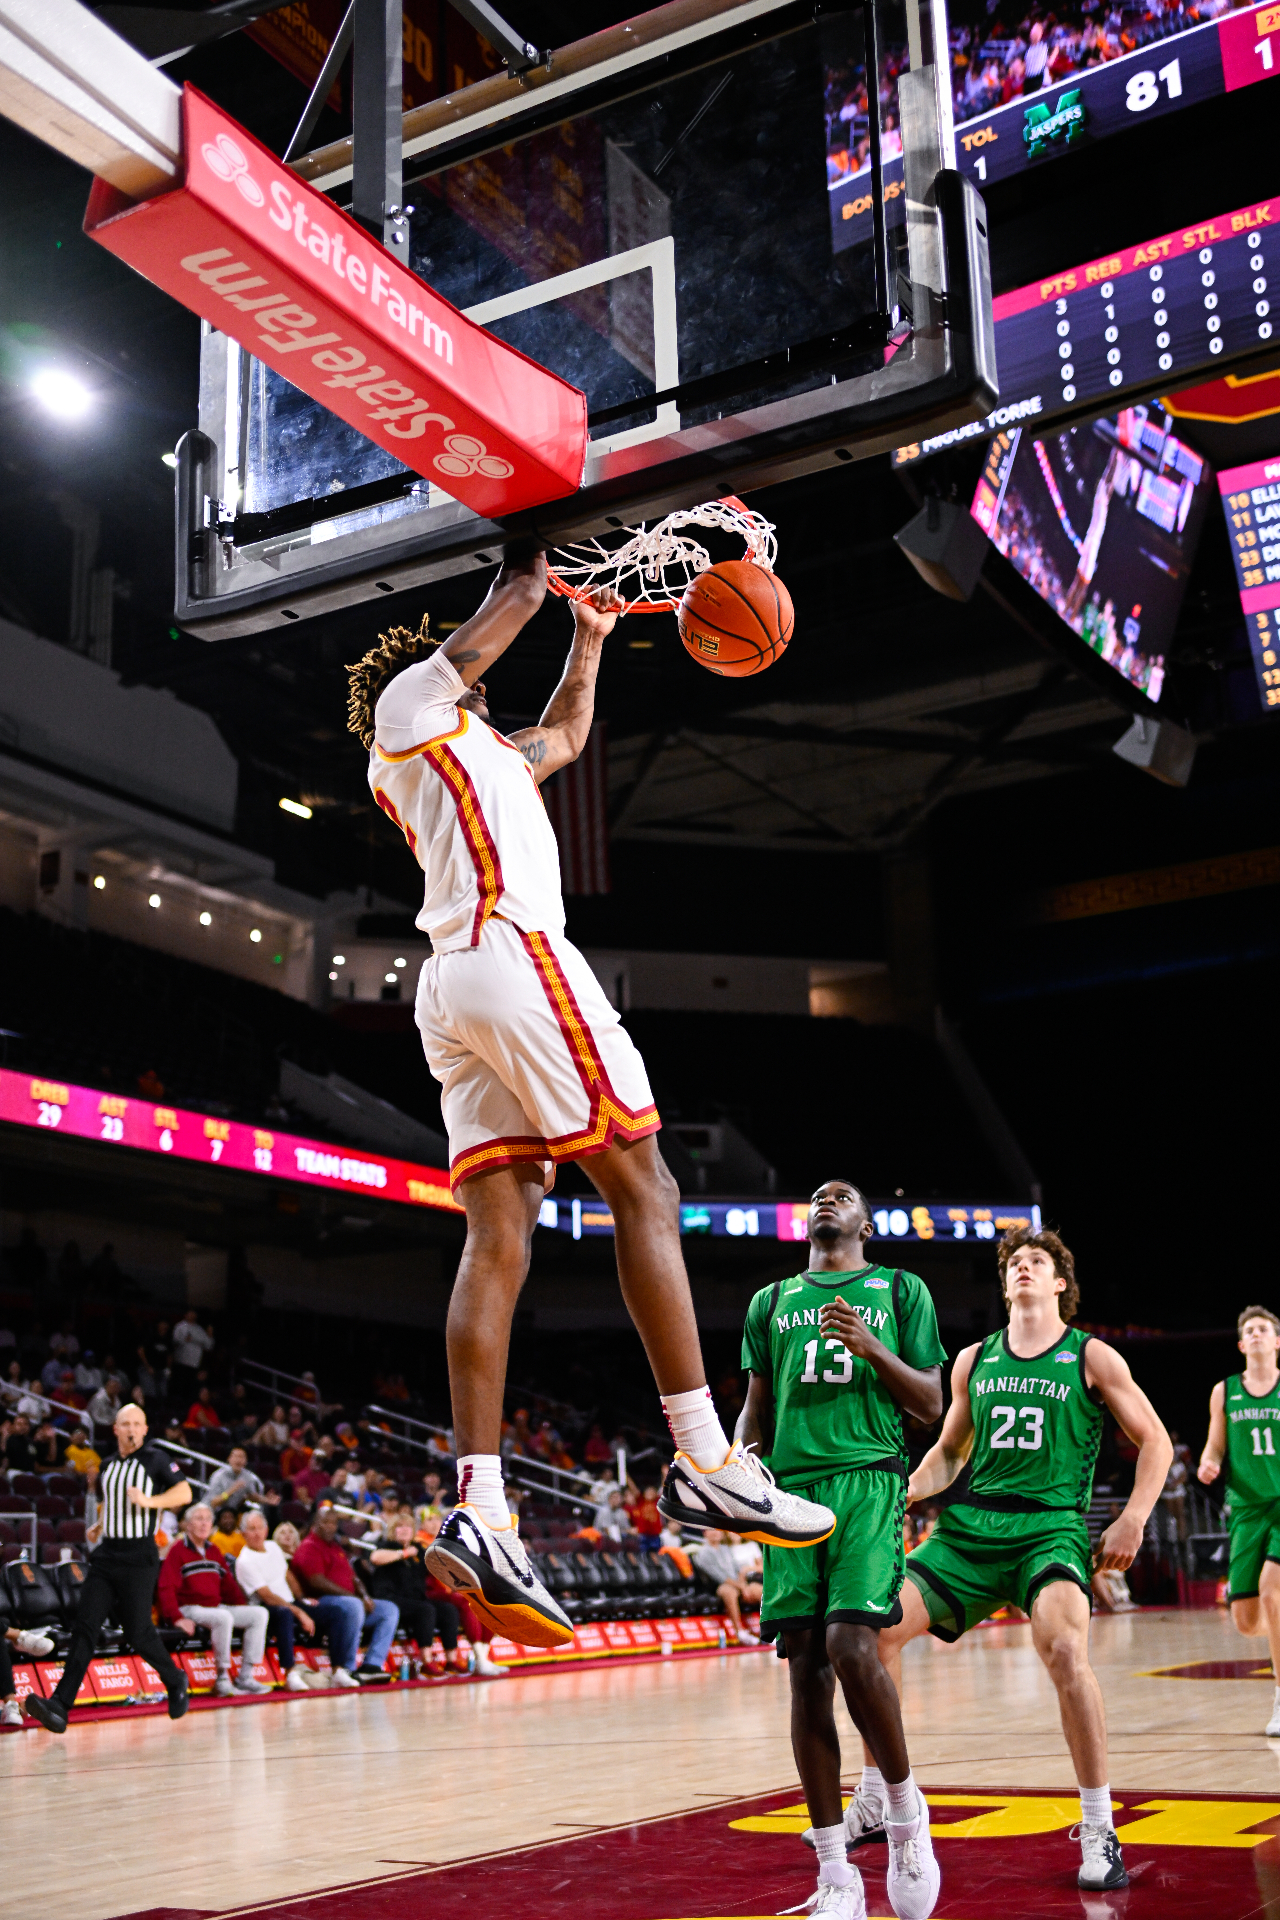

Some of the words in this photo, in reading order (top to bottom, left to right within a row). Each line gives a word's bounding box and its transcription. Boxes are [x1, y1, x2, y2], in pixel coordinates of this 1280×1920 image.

[1254, 37, 1273, 70] 1
[1126, 57, 1182, 111] 81
[1029, 105, 1082, 141] JASPERS
[961, 126, 998, 151] TOL
[974, 156, 987, 180] 1
[1040, 274, 1077, 300] PTS
[1085, 258, 1122, 283] REB
[1133, 240, 1172, 266] AST
[1182, 224, 1222, 249] STL
[1231, 205, 1272, 232] BLK
[269, 180, 455, 366] StateFarm
[1055, 298, 1068, 315] 3
[1100, 281, 1114, 299] 0
[1149, 264, 1163, 282] 0
[1199, 247, 1213, 265] 0
[1247, 231, 1262, 249] 0
[1056, 319, 1070, 337] 0
[1105, 303, 1115, 320] 1
[1151, 286, 1166, 304] 0
[1201, 269, 1216, 287] 0
[1250, 254, 1264, 271] 0
[1058, 341, 1073, 359] 0
[1104, 325, 1119, 343] 0
[1154, 309, 1168, 327] 0
[1204, 292, 1218, 310] 0
[1252, 276, 1267, 294] 0
[180, 247, 455, 439] StateFarm
[1060, 363, 1074, 381] 0
[1107, 347, 1121, 365] 0
[1156, 331, 1171, 349] 0
[1206, 315, 1221, 333] 0
[1255, 299, 1270, 317] 0
[1062, 384, 1077, 402] 0
[1109, 368, 1123, 387] 0
[1158, 352, 1173, 371] 0
[1209, 336, 1224, 354] 0
[1258, 321, 1273, 339] 0
[922, 421, 985, 453] MIGUEL
[985, 394, 1043, 428] TORRE
[1228, 492, 1250, 511] 10
[1231, 511, 1251, 529] 11
[1235, 530, 1257, 549] 13
[1239, 549, 1261, 568] 23
[1256, 613, 1269, 629] 3
[1259, 631, 1272, 647] 7
[37, 1101, 62, 1127] 29
[101, 1116, 123, 1140] 23
[159, 1129, 173, 1151] 6
[210, 1139, 223, 1161] 7
[294, 1147, 340, 1179] TEAM
[341, 1157, 387, 1189] STATS
[726, 1208, 759, 1235] 81
[776, 1305, 888, 1334] MANTAN
[800, 1339, 853, 1384] 13
[976, 1376, 1071, 1402] MANHATTAN
[991, 1405, 1044, 1450] 23
[1250, 1427, 1276, 1455] 11
[94, 1663, 130, 1676] WELLS
[100, 1676, 134, 1689] FARGO
